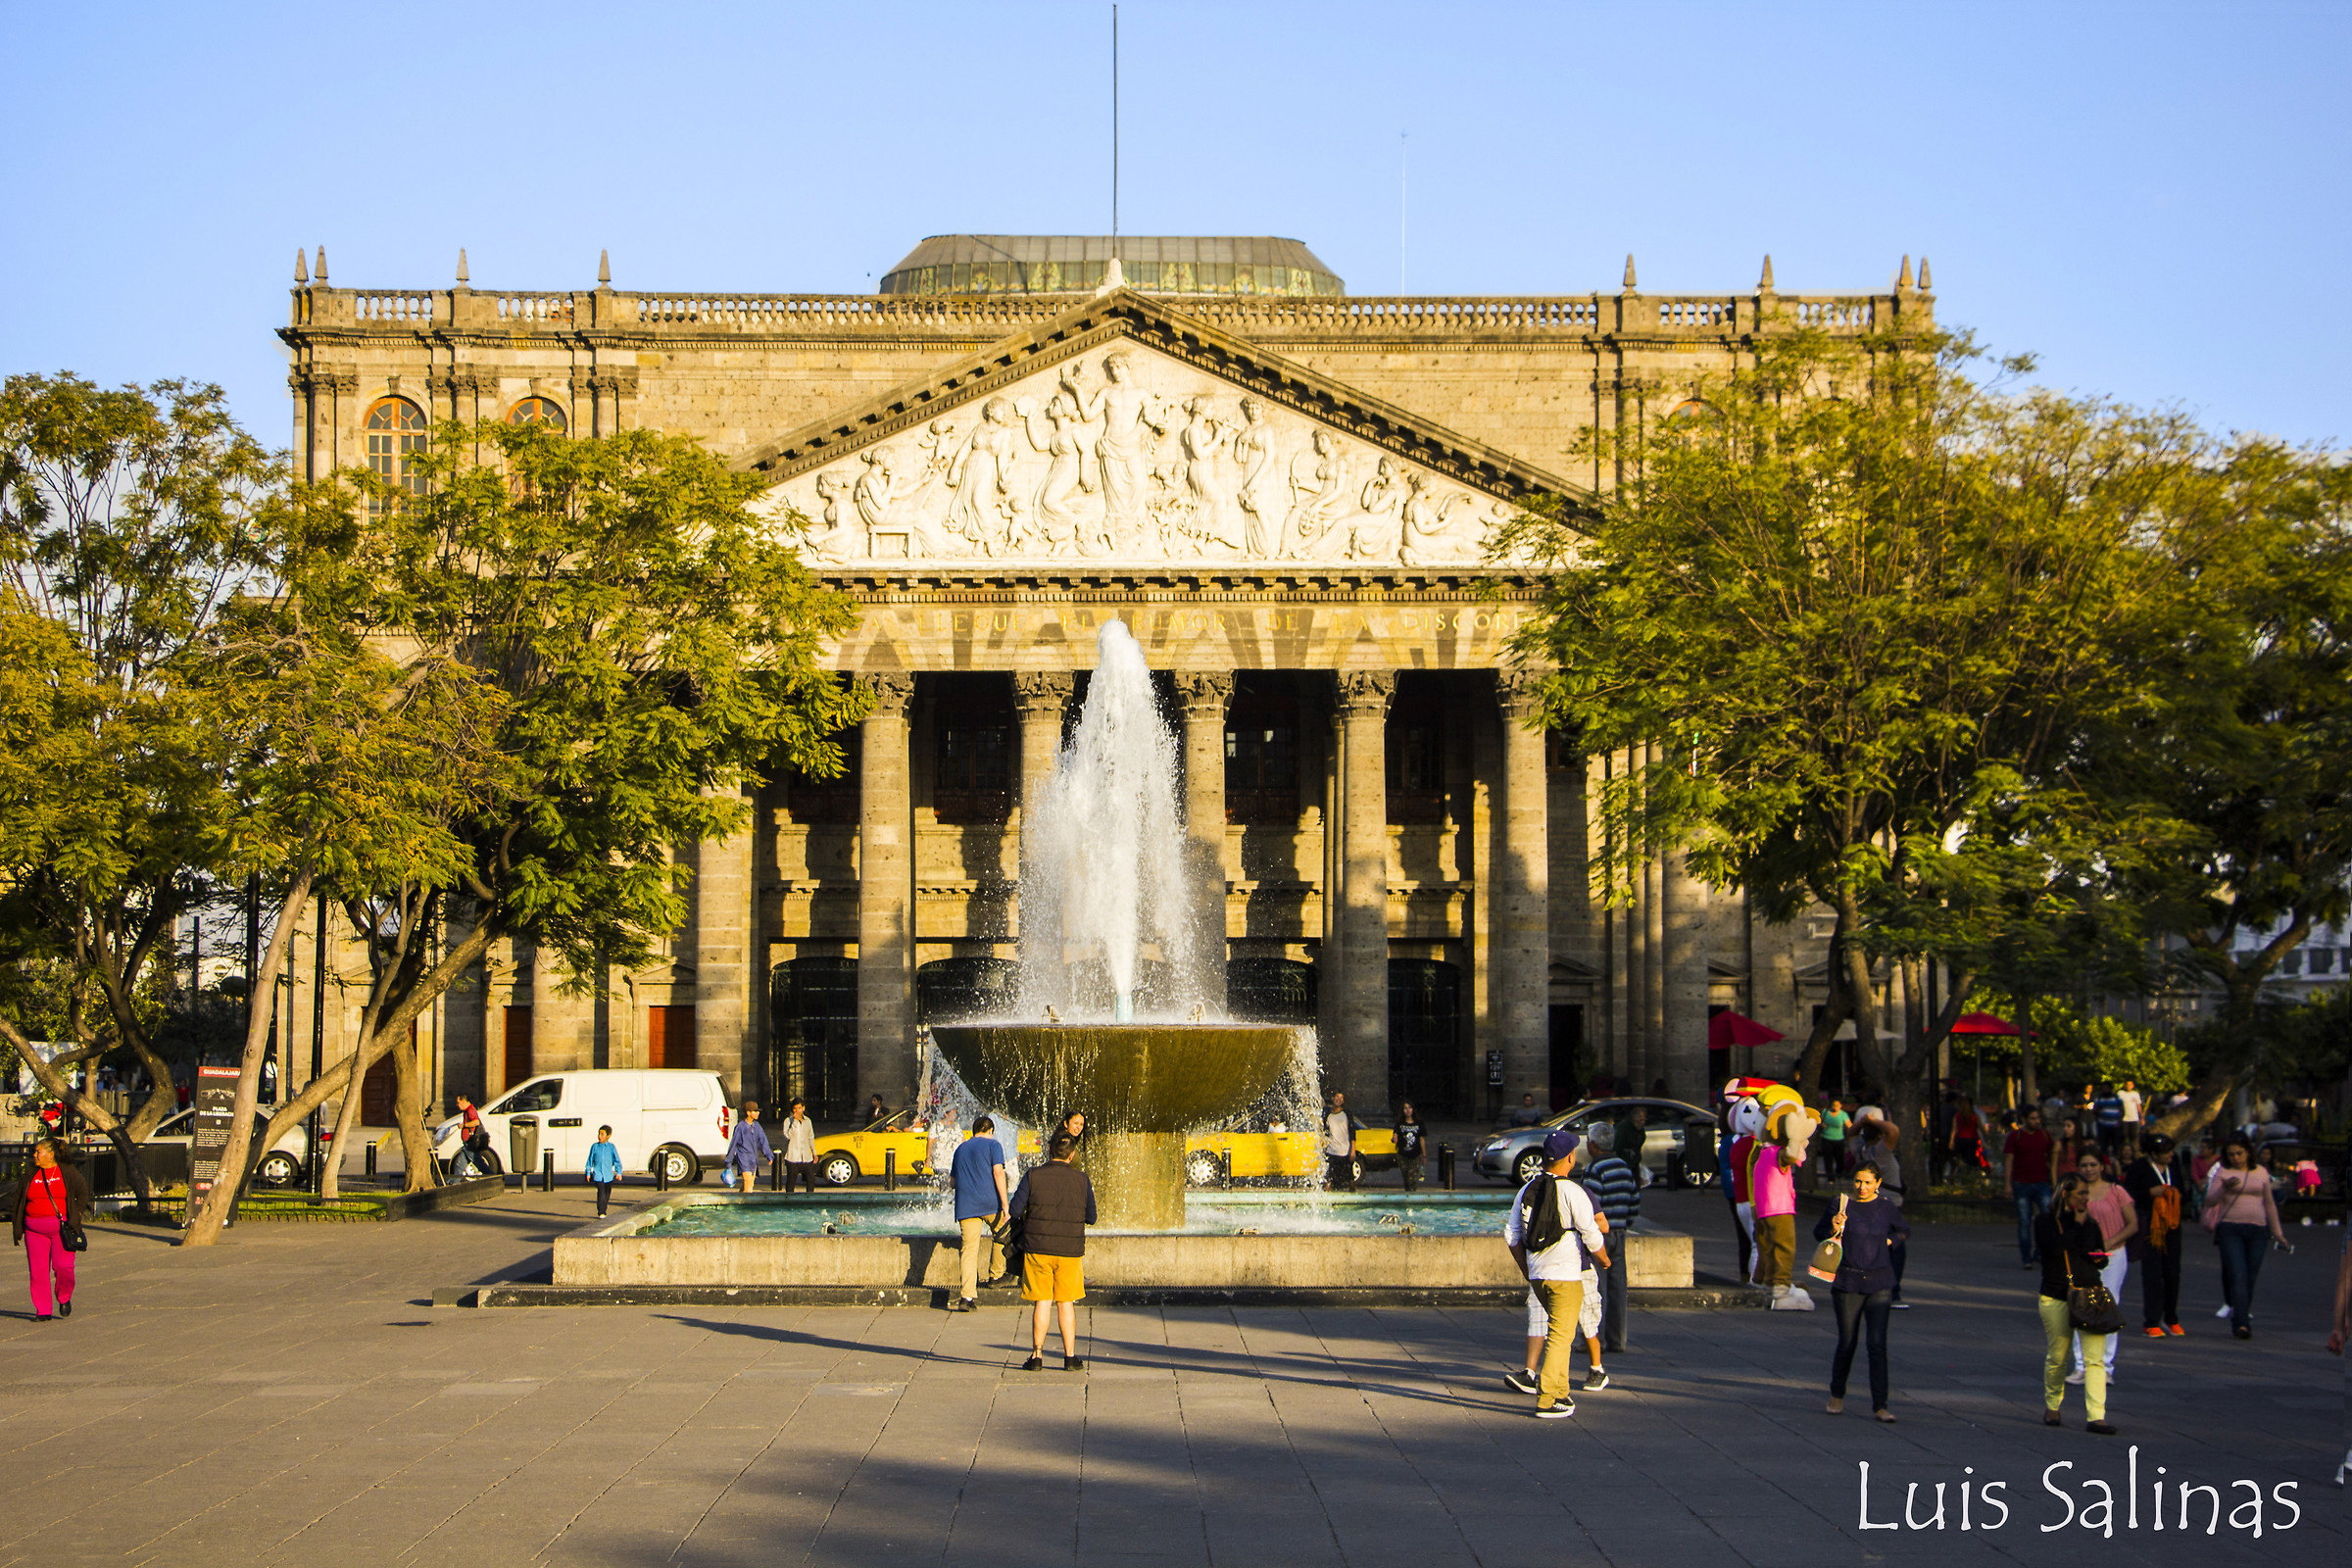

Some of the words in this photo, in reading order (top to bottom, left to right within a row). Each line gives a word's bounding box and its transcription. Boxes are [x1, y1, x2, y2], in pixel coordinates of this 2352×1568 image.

[918, 613, 1024, 632] LLEGUE
[1062, 613, 1093, 631] EL
[1131, 613, 1228, 631] RUMOR
[1266, 612, 1299, 631] DE
[1334, 613, 1370, 631] LA
[1403, 612, 1556, 631] DISCOR
